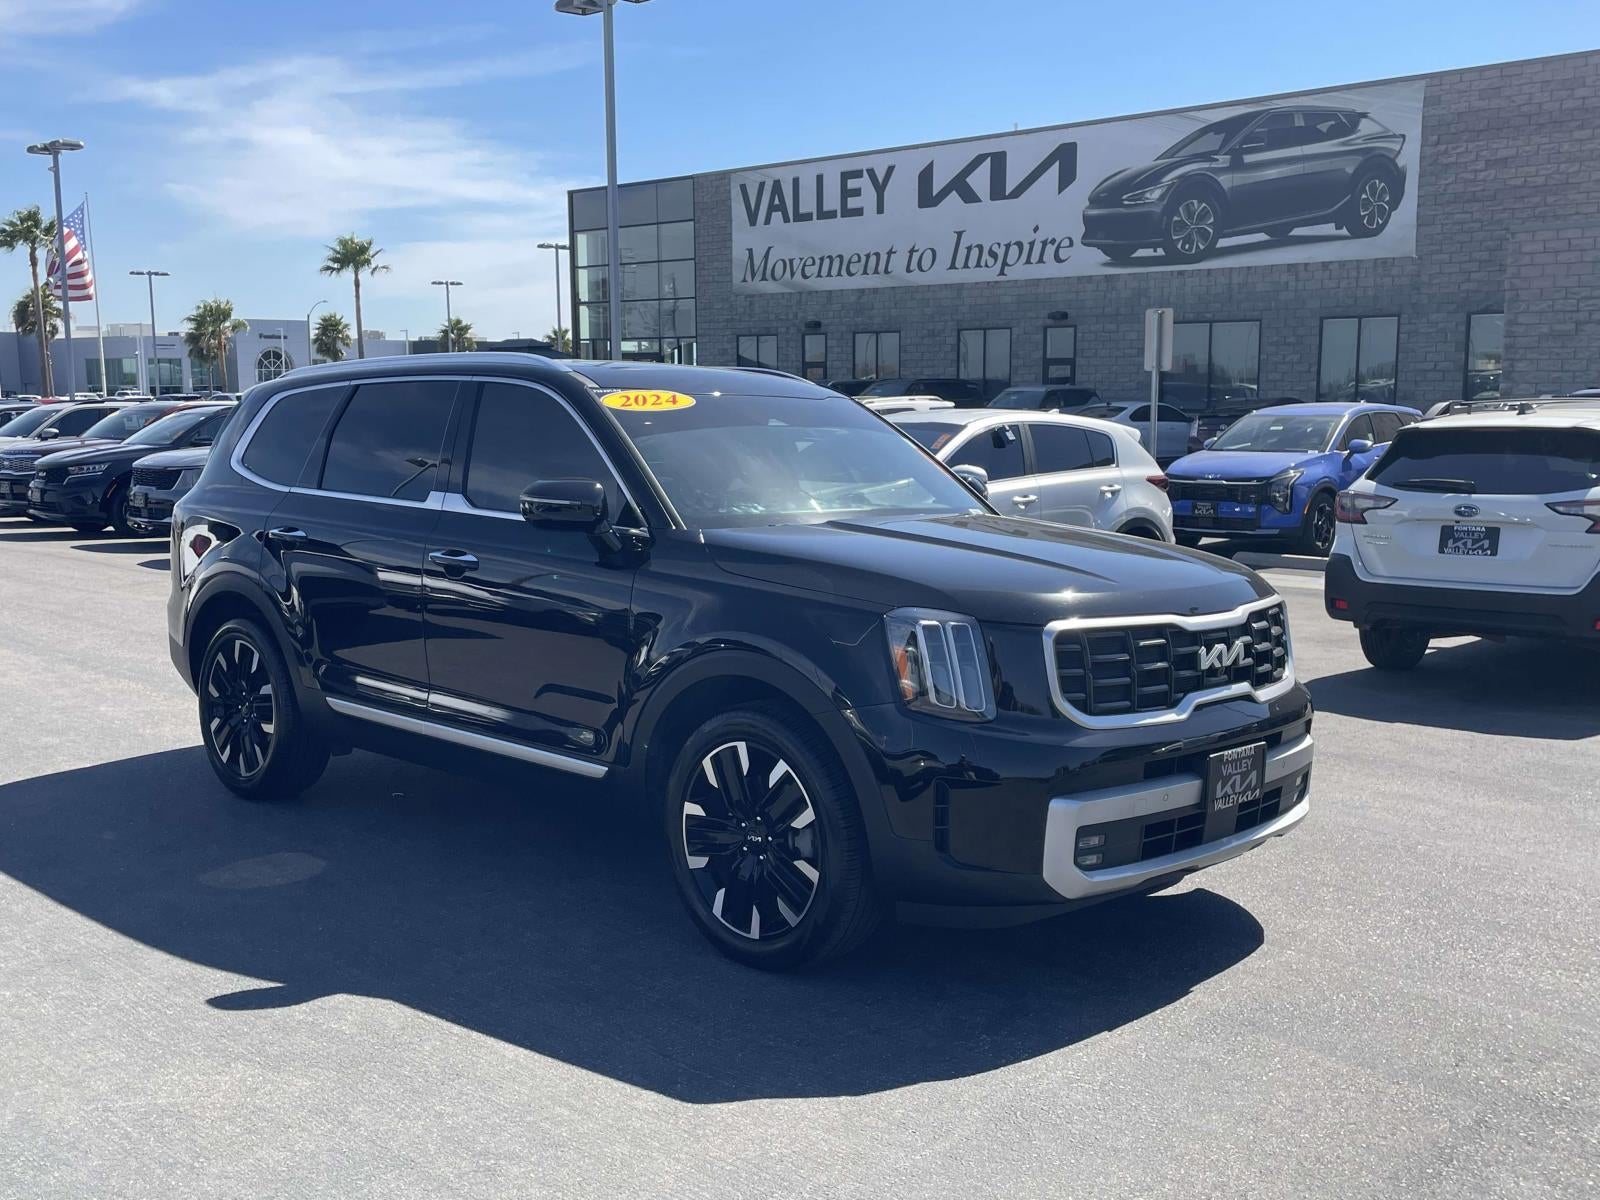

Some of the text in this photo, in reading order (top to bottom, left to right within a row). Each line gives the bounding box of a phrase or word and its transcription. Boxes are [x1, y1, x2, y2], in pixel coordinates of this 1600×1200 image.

[739, 141, 1078, 227] VALLEY KIA
[741, 223, 1075, 283] Movement to Inspire
[619, 394, 679, 407] 2024
[1448, 538, 1490, 550] KIA
[1199, 639, 1246, 670] KIA
[1224, 746, 1255, 762] FONTANA
[1221, 757, 1253, 777] VALLEY
[1215, 769, 1258, 799] KIA
[1213, 792, 1240, 812] VALLEY
